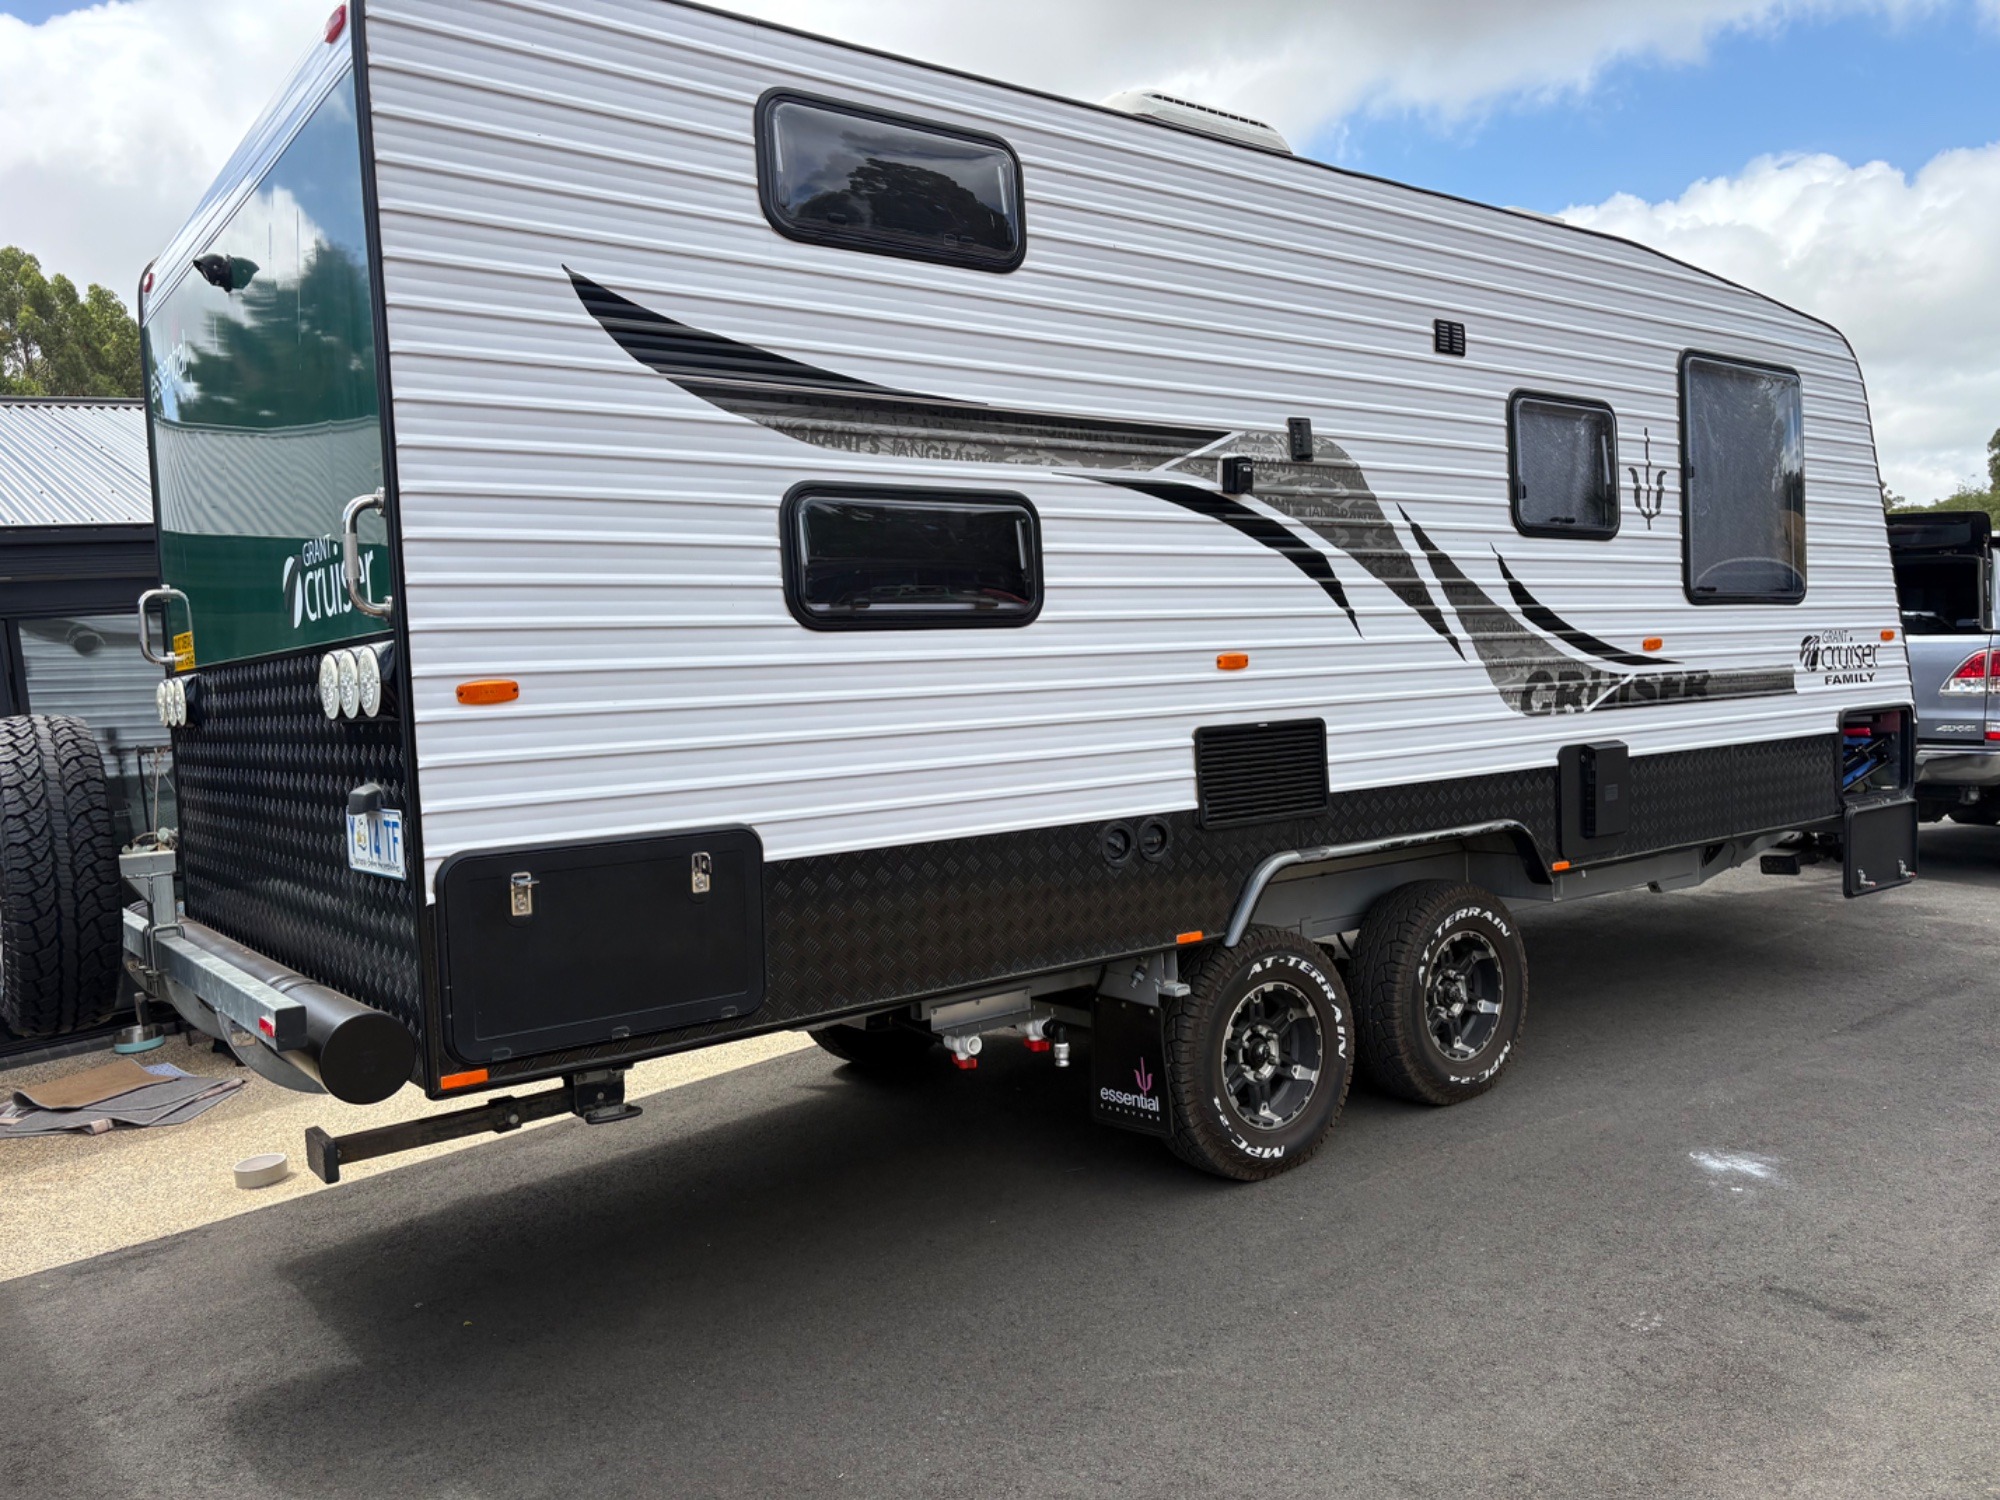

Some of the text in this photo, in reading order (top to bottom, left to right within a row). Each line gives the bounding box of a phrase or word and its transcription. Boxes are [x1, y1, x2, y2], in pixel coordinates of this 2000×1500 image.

[303, 533, 331, 567] GRANT
[1822, 629, 1848, 643] GRANT
[1821, 636, 1881, 670] cruiser
[1520, 669, 1710, 715] CRUISER
[1825, 672, 1876, 685] FAMILY
[1100, 1087, 1160, 1112] essential
